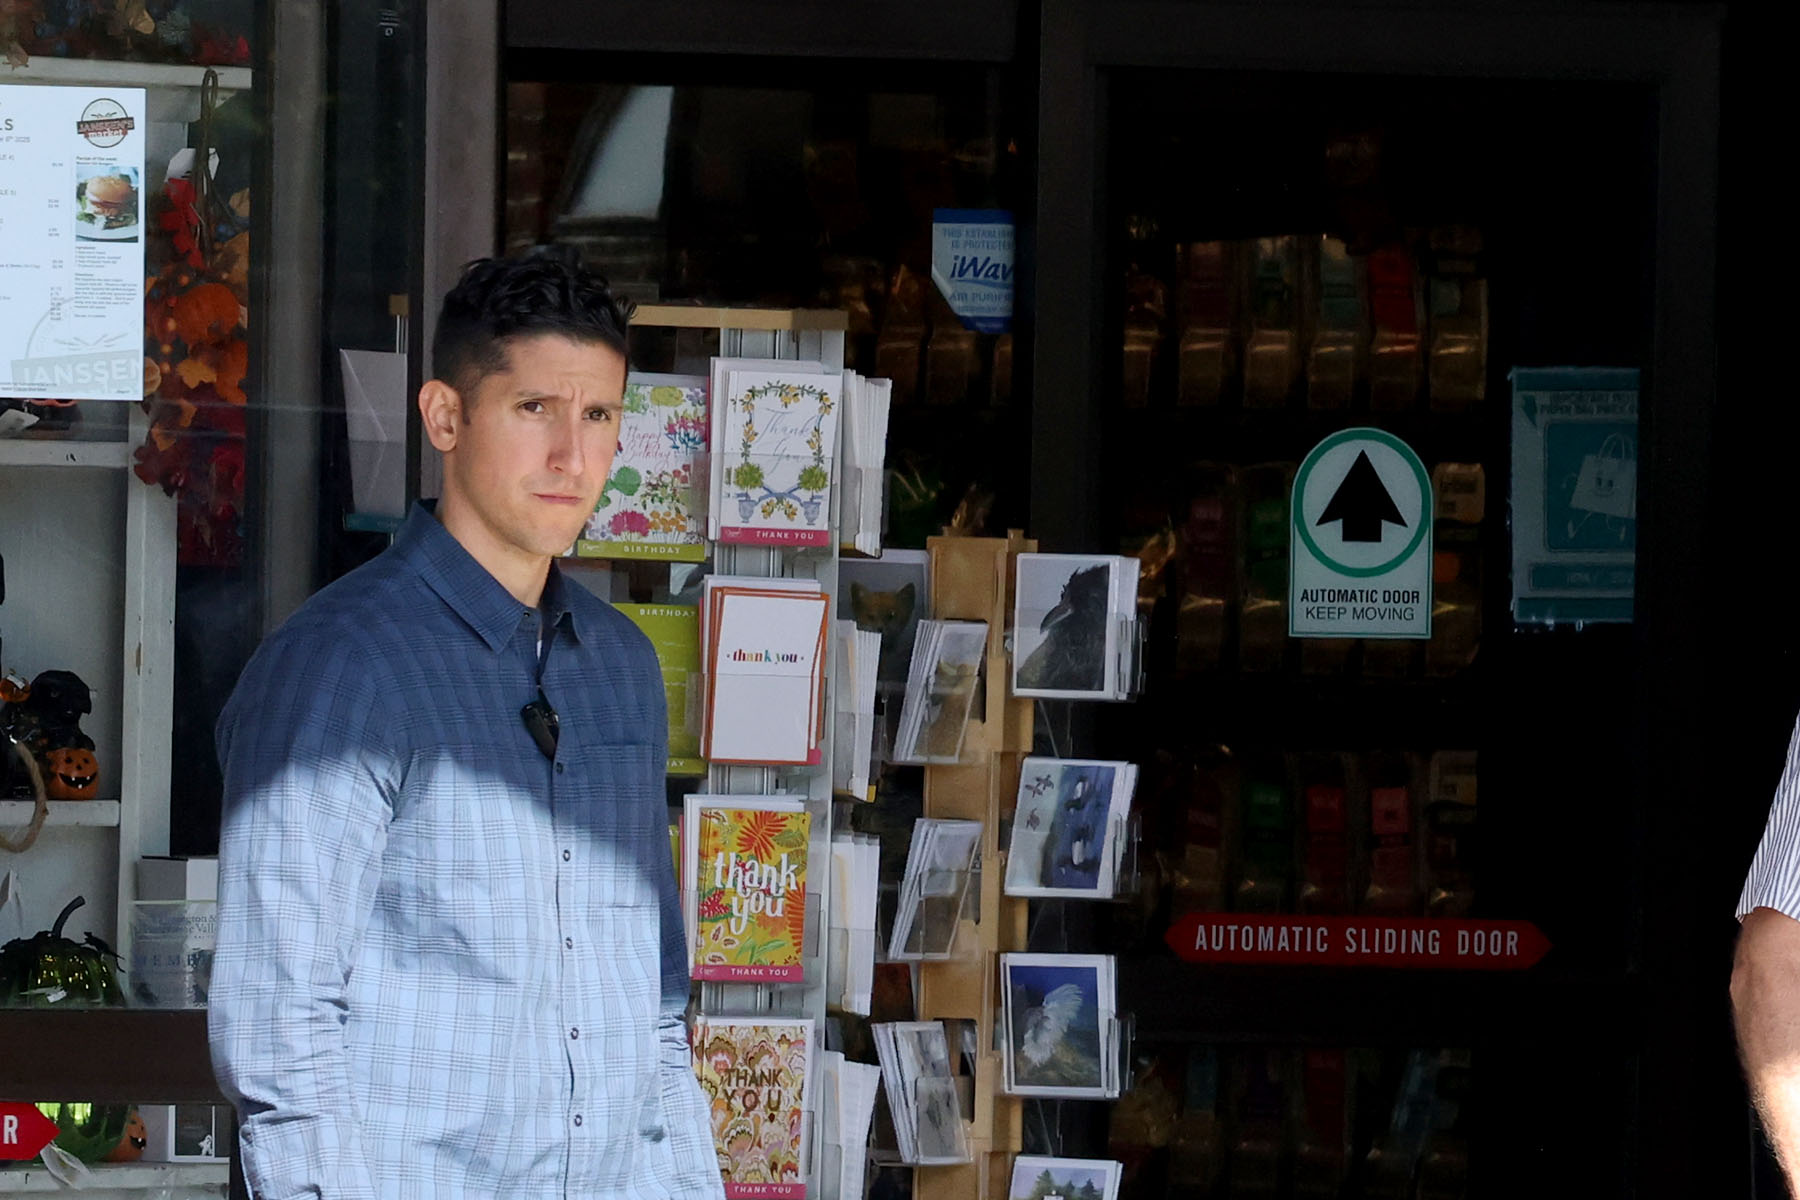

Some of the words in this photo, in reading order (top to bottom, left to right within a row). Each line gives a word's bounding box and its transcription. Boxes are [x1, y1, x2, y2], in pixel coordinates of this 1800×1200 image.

[755, 532, 793, 541] THANK
[794, 532, 815, 541] YOU
[623, 544, 681, 554] BIRTHDAY
[1300, 588, 1378, 604] AUTOMATIC
[1382, 590, 1420, 604] DOOR
[639, 608, 696, 618] BIRTHDAY
[1305, 606, 1347, 620] KEEP
[1352, 607, 1415, 621] MOVING
[732, 648, 772, 662] thank
[774, 650, 798, 664] you
[714, 851, 798, 898] thank
[730, 888, 785, 936] you
[1195, 925, 1329, 952] AUTOMATIC
[1344, 927, 1441, 955] SLIDING
[1457, 930, 1519, 956] DOOR
[731, 968, 764, 976] THANK
[769, 968, 790, 977] YOU
[725, 1068, 783, 1088] THANK
[724, 1089, 782, 1112] YOU
[734, 1186, 768, 1194] THANK
[772, 1186, 792, 1194] YOU
